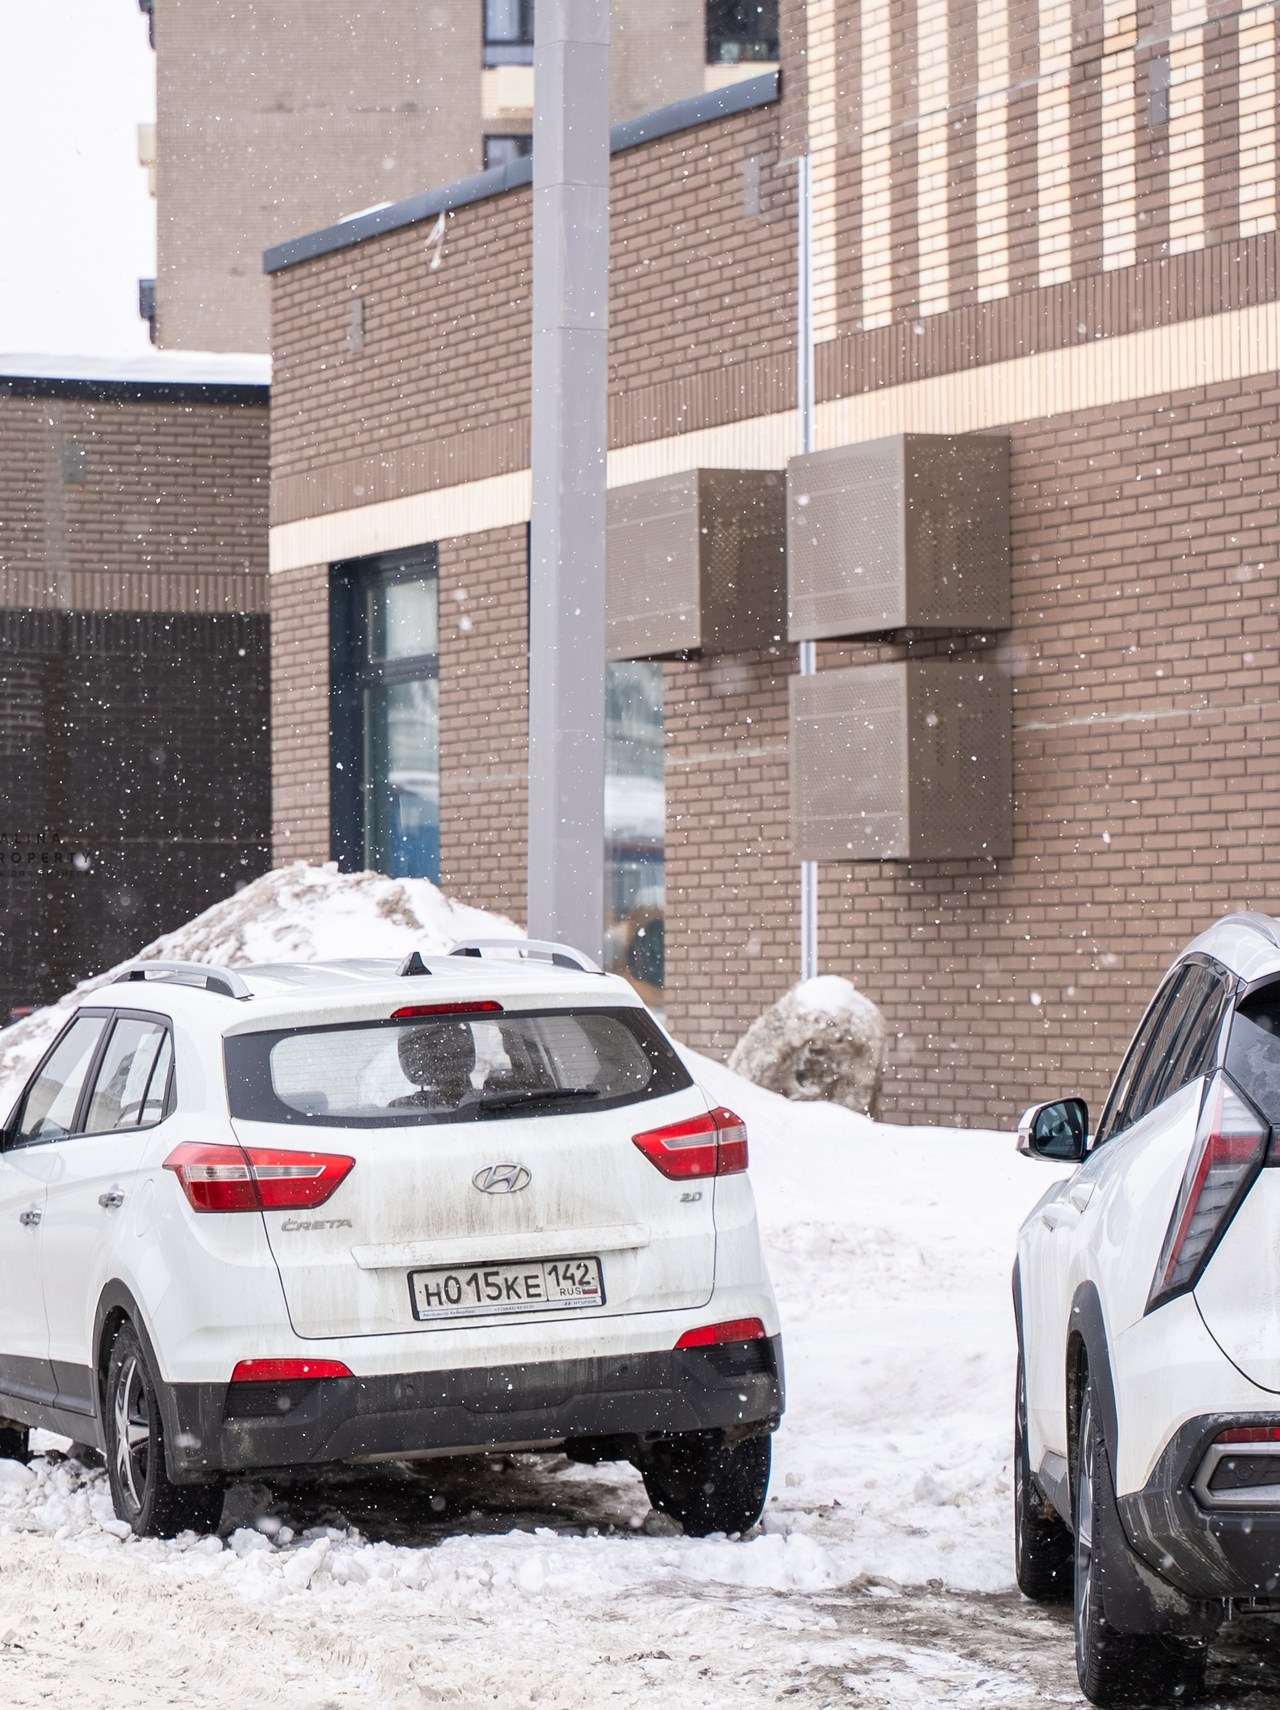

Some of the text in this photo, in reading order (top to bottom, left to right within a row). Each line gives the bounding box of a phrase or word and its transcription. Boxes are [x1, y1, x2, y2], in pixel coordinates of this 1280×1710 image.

[281, 1219, 352, 1232] CRETA
[547, 1263, 591, 1287] 142
[560, 1286, 581, 1296] RUS
